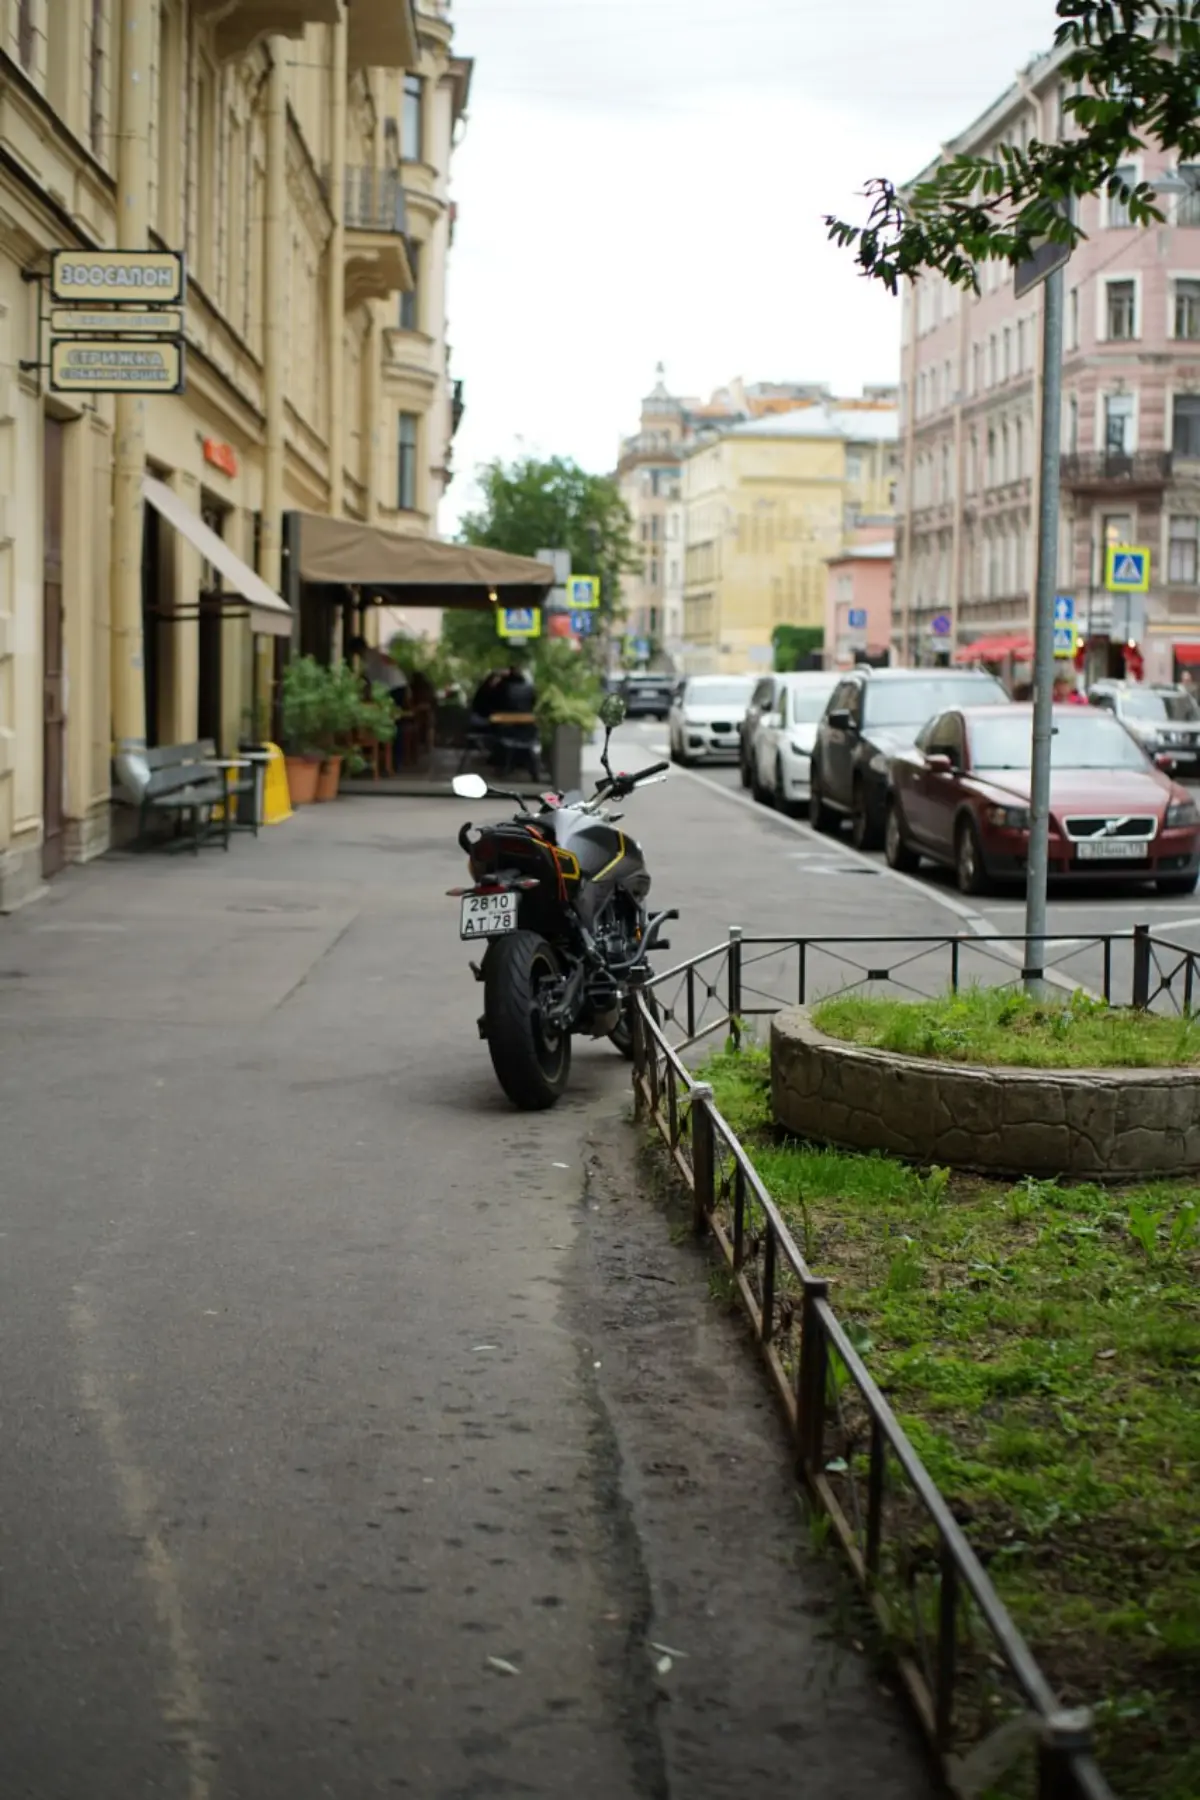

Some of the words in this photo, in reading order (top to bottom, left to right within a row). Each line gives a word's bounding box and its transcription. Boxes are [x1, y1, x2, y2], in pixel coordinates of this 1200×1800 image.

[60, 264, 173, 287] ЗООСАЛОН
[470, 895, 509, 912] 2810
[493, 915, 511, 928] 78
